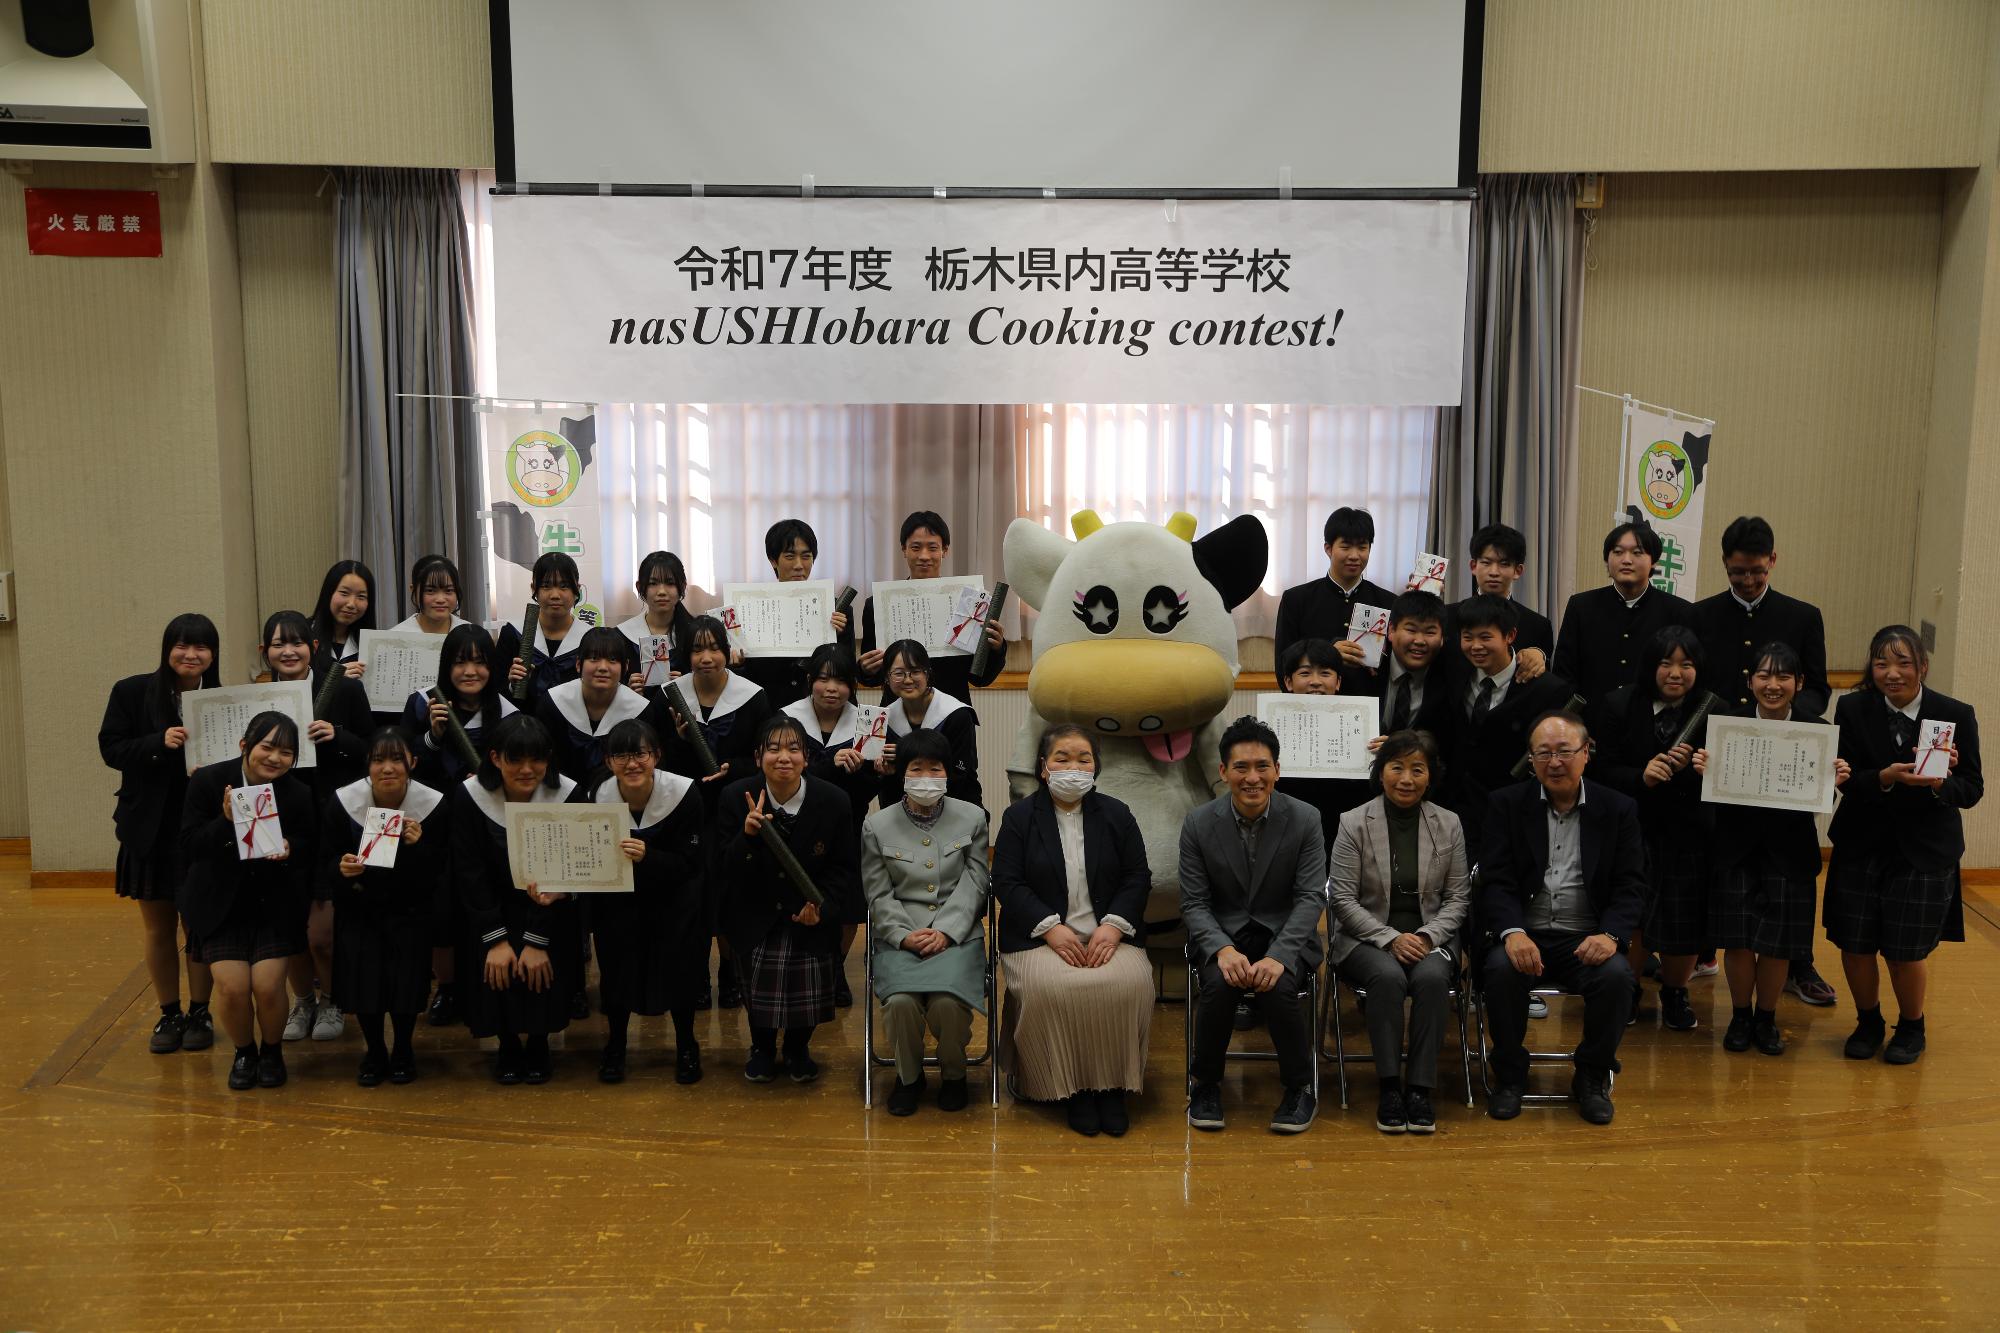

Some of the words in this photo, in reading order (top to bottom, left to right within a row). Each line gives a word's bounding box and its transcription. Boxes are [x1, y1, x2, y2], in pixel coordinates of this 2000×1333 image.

[47, 213, 141, 233] 火気厳禁
[673, 245, 893, 292] 令和7年度
[924, 246, 1291, 293] 栃木県内高等学校
[608, 305, 951, 345] nasUSHIobara
[968, 306, 1156, 357] Cooking
[1168, 308, 1344, 347] contest!
